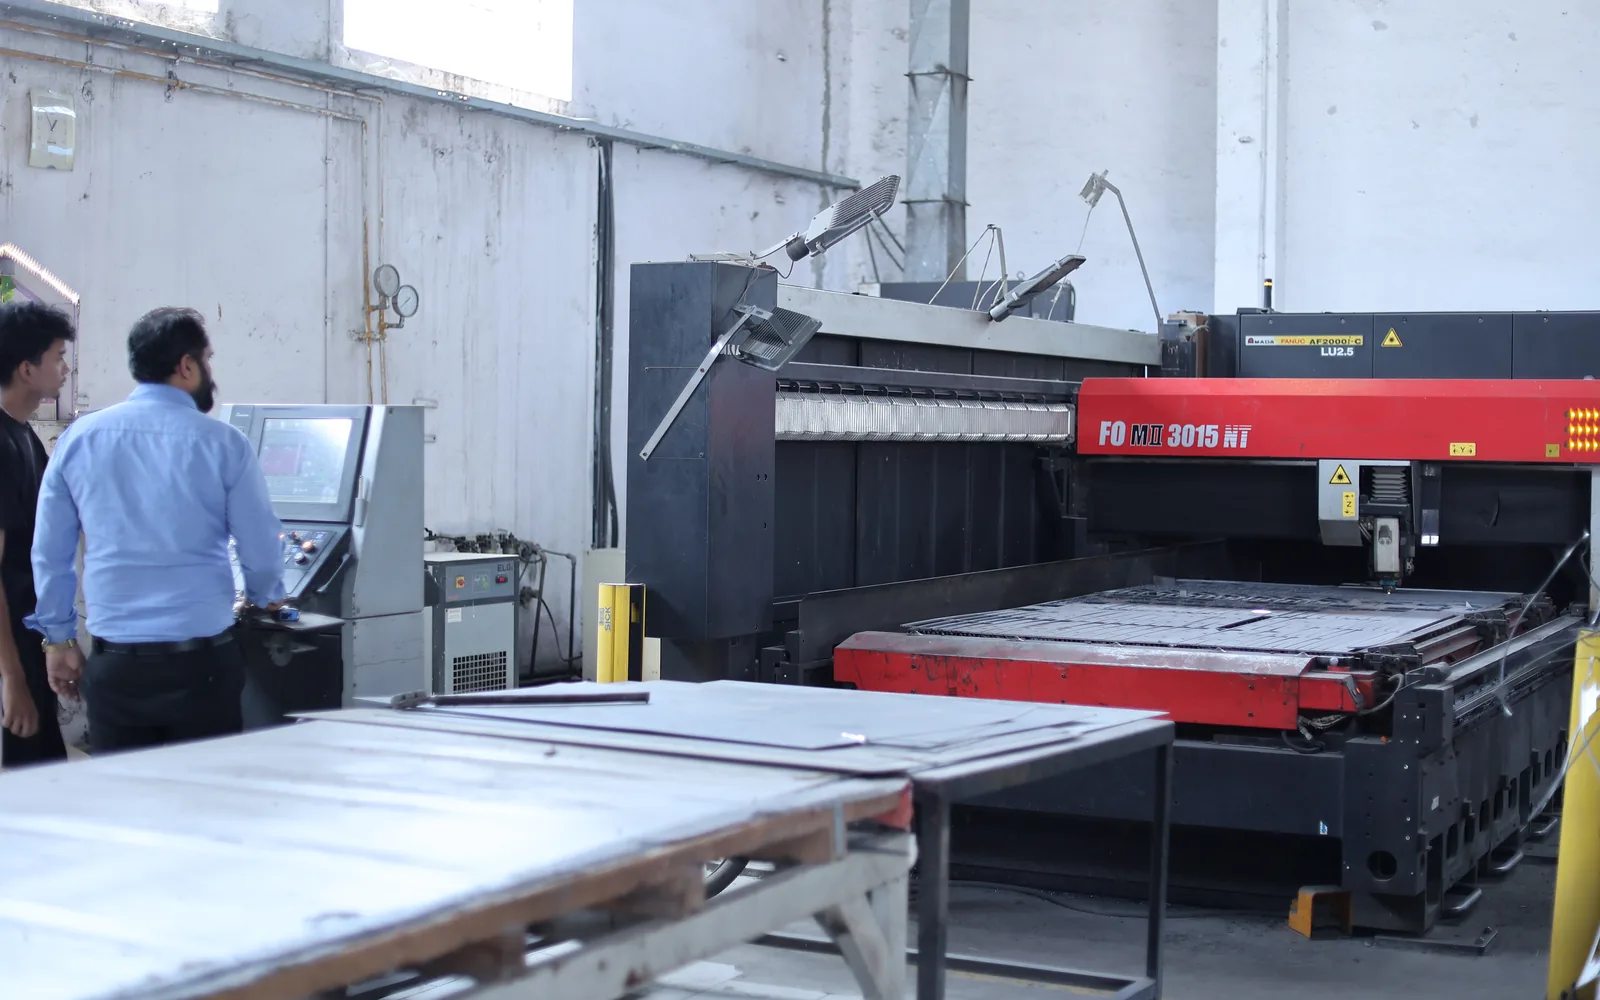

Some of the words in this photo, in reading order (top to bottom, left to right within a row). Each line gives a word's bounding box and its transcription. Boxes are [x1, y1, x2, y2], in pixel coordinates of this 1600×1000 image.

[1321, 347, 1354, 356] LU2.5
[1099, 420, 1127, 447] FO
[1167, 423, 1219, 448] 3015
[1223, 424, 1252, 448] NT
